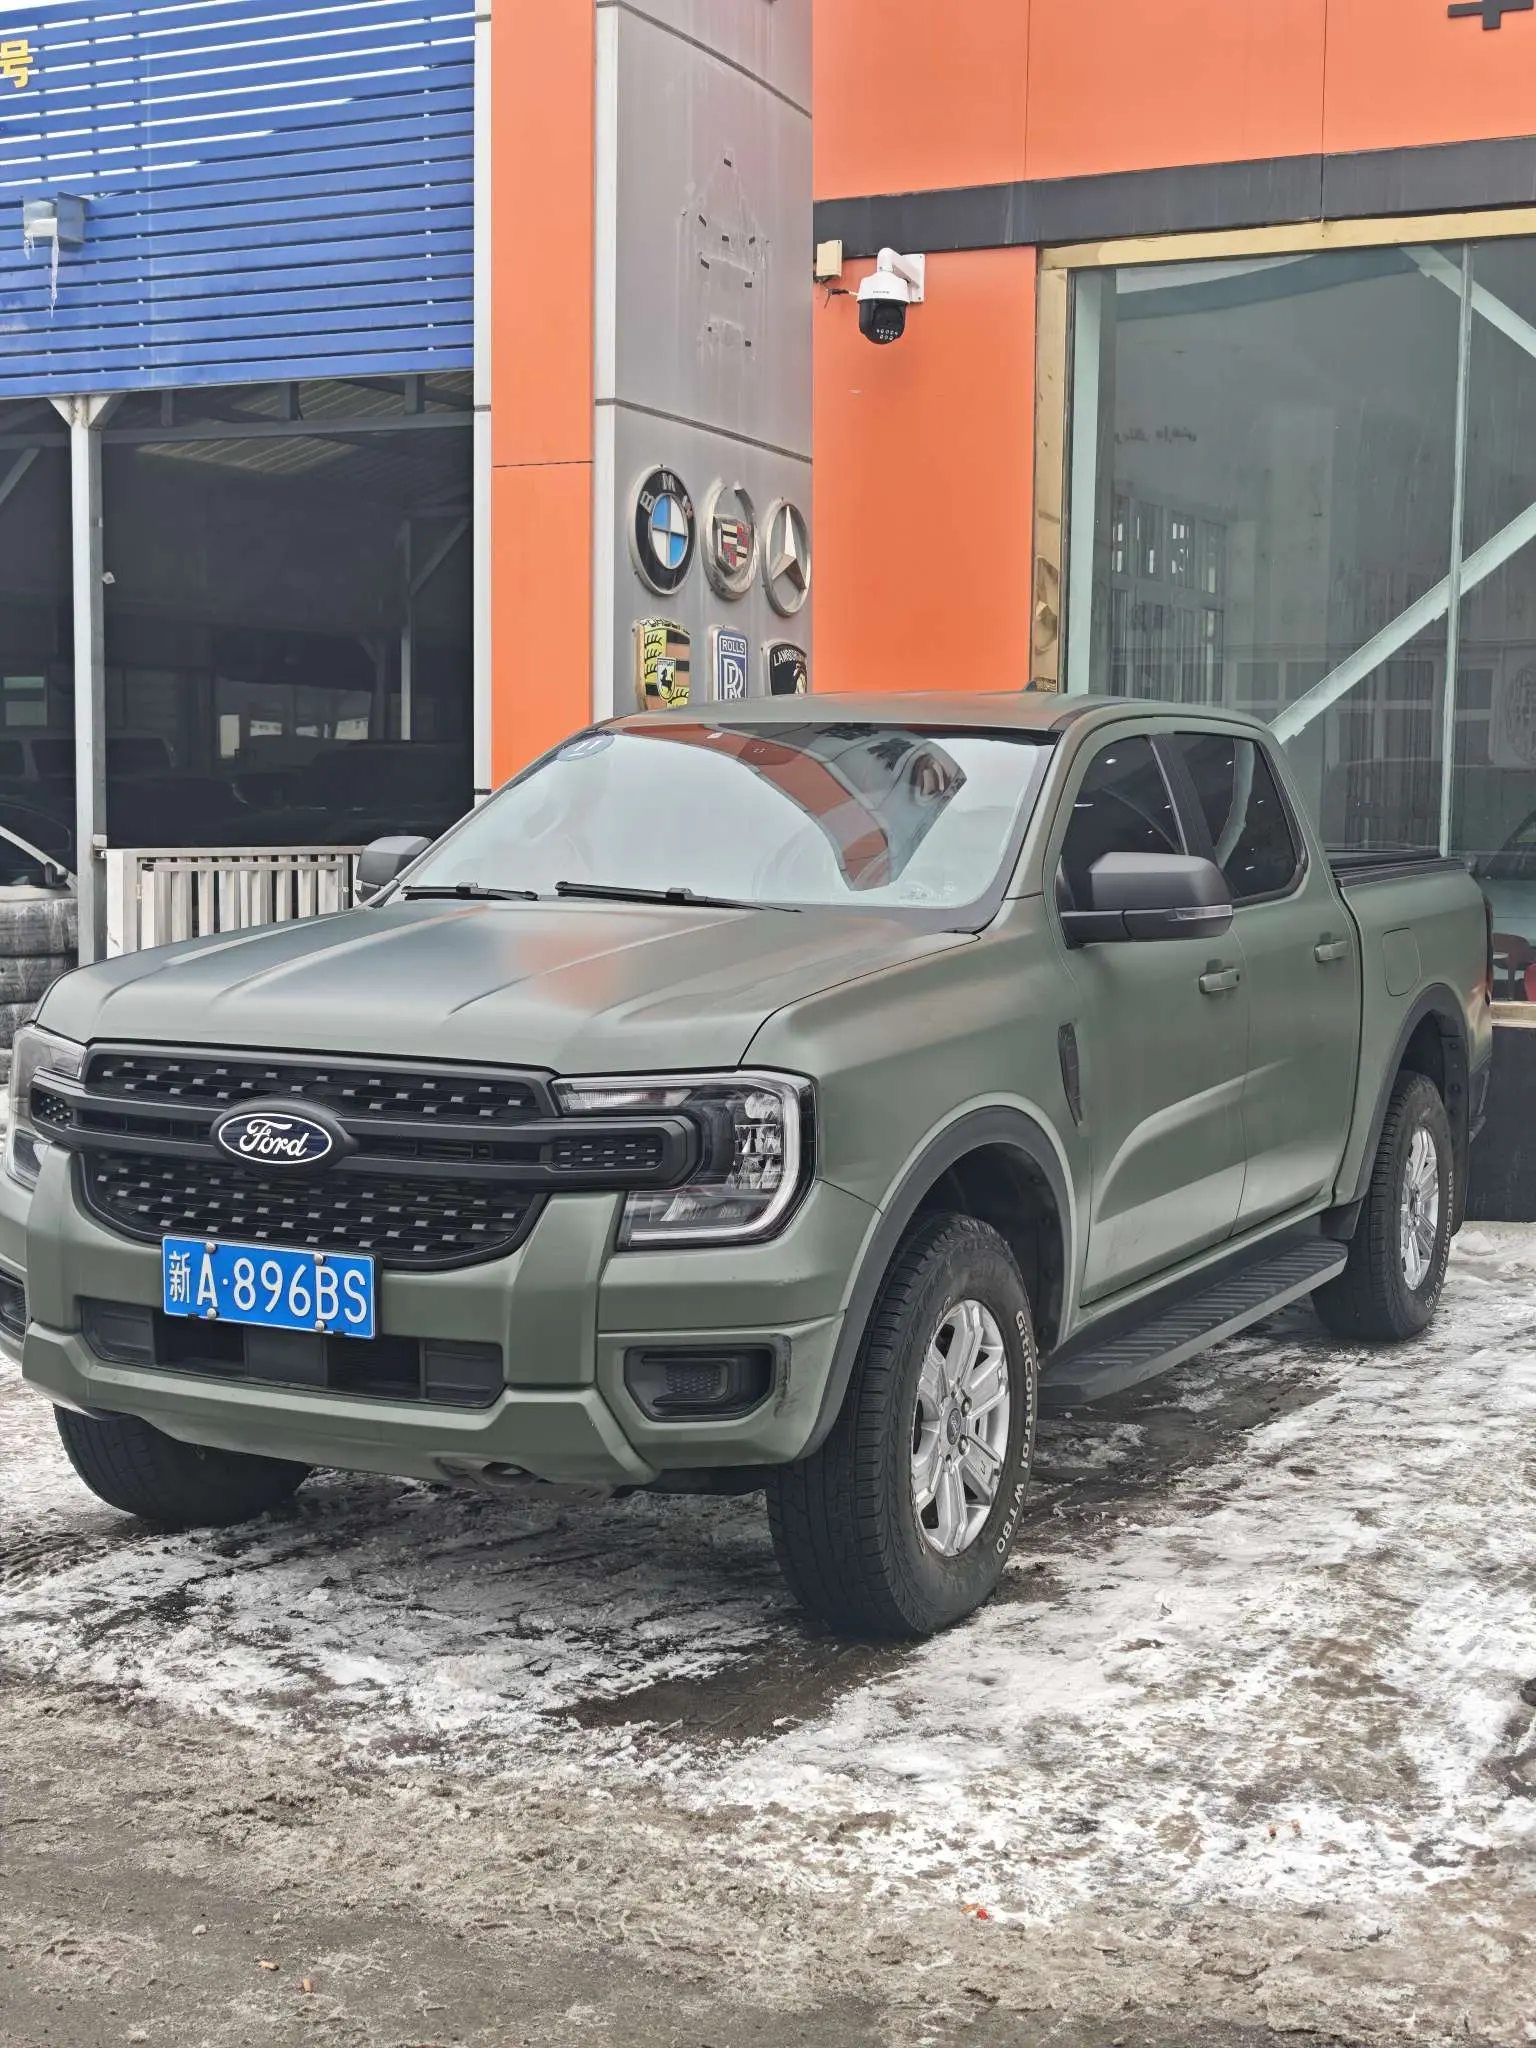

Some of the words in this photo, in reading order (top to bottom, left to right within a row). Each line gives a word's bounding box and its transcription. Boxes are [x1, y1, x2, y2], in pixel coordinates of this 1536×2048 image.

[721, 639, 745, 654] ROLLS
[239, 1118, 310, 1157] Ford
[1015, 1310, 1034, 1470] GitiControl
